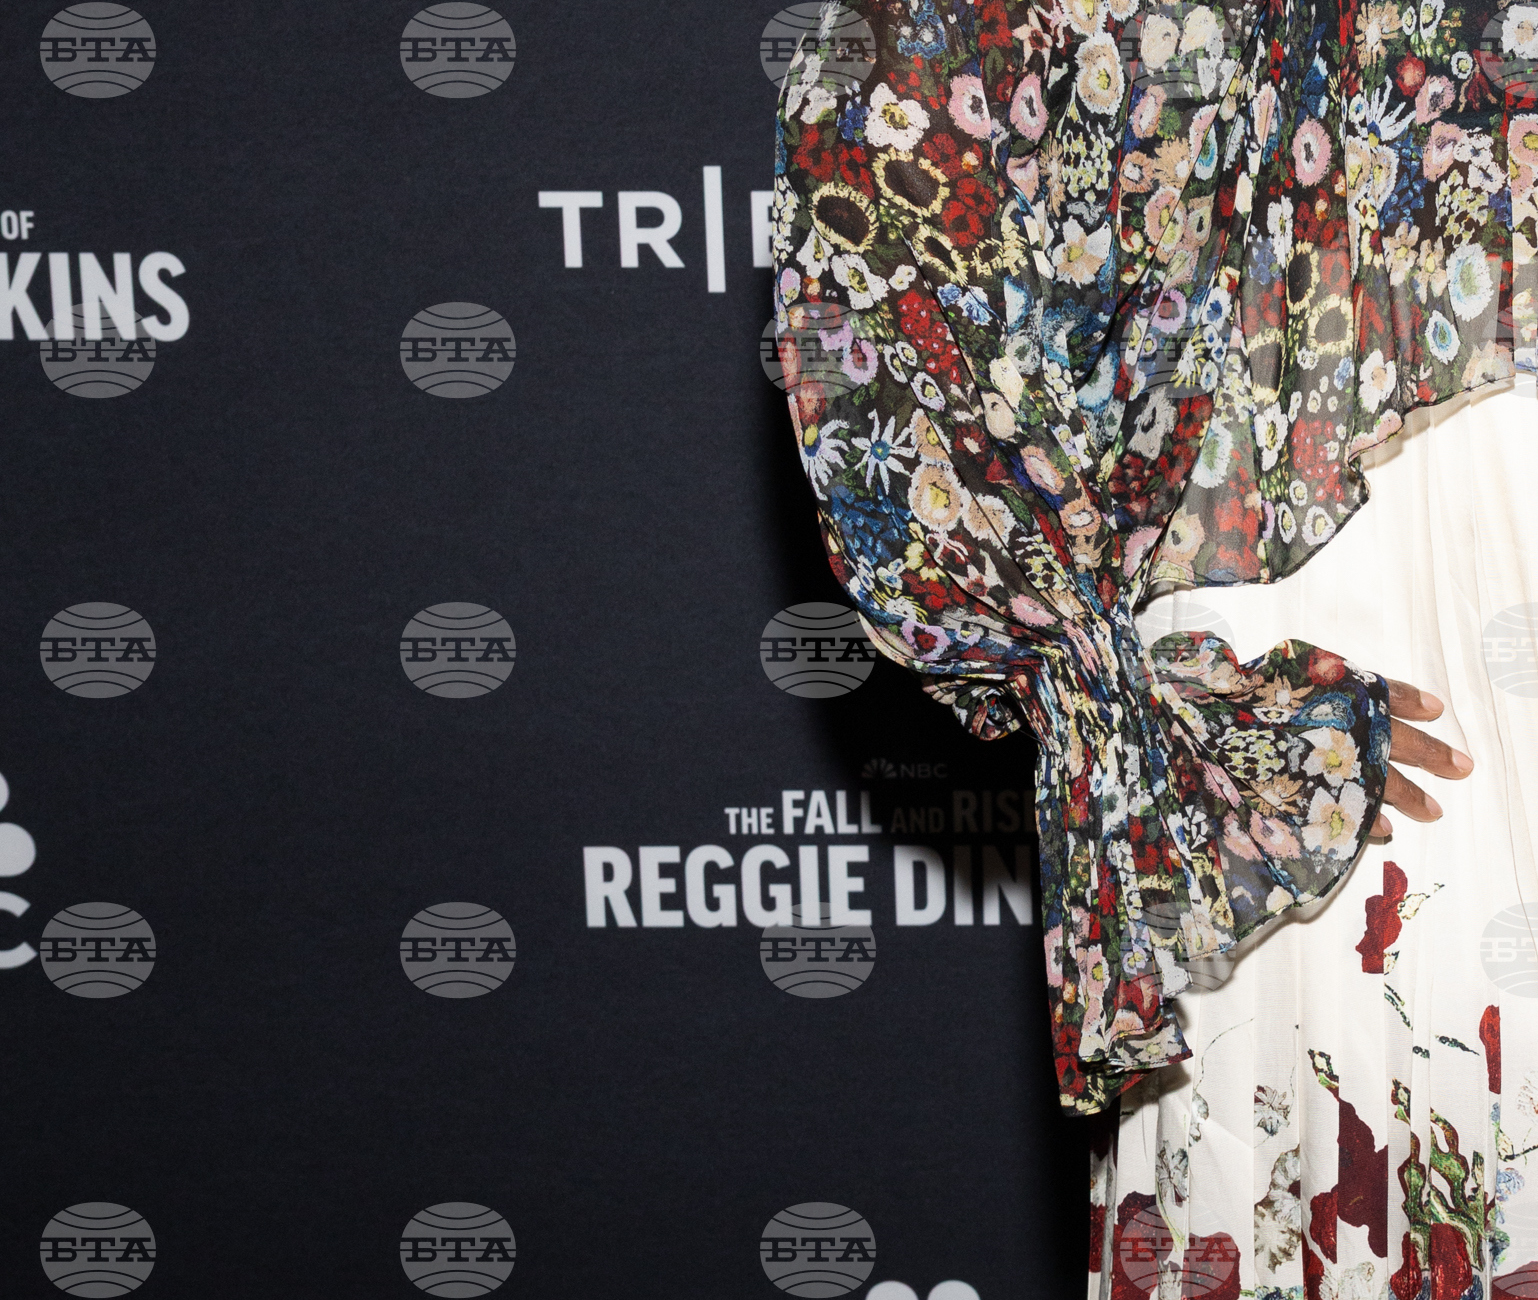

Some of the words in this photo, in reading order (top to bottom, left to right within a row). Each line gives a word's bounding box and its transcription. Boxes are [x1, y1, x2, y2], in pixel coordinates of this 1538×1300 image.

[0, 210, 34, 240] OF
[0, 252, 190, 342] KINS
[900, 762, 949, 779] NBC
[724, 807, 774, 834] THE
[781, 790, 881, 835] FALL
[889, 807, 945, 834] AND
[583, 845, 872, 928] REGGIE
[893, 845, 1034, 927] DIN
